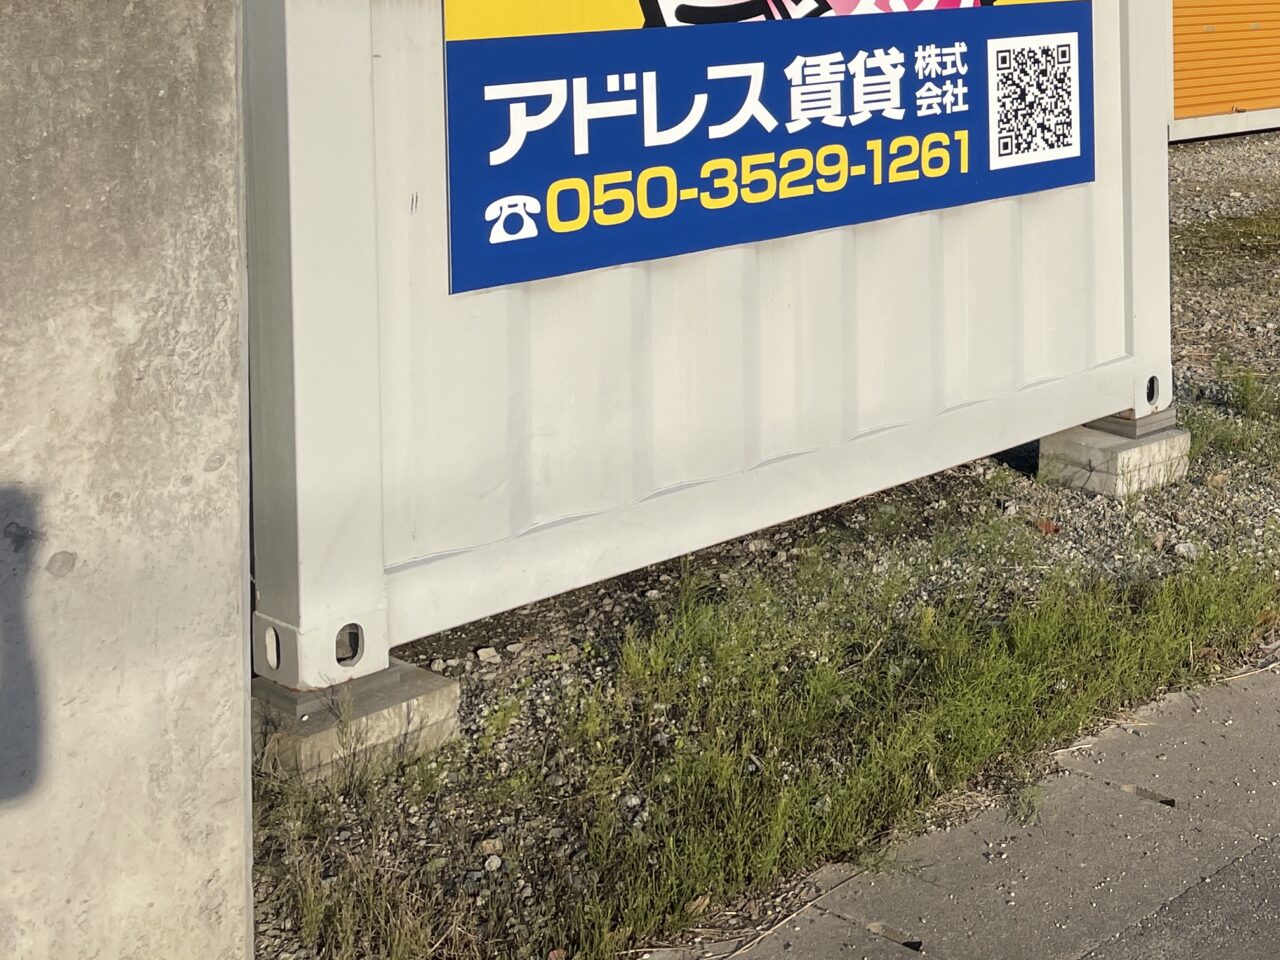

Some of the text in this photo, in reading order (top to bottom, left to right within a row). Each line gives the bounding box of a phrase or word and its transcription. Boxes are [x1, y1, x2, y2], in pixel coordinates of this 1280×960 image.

[914, 40, 968, 79] 株式
[484, 47, 905, 165] アドレス賃貸
[916, 79, 969, 118] 会社
[545, 129, 971, 234] 050-3529-1261
